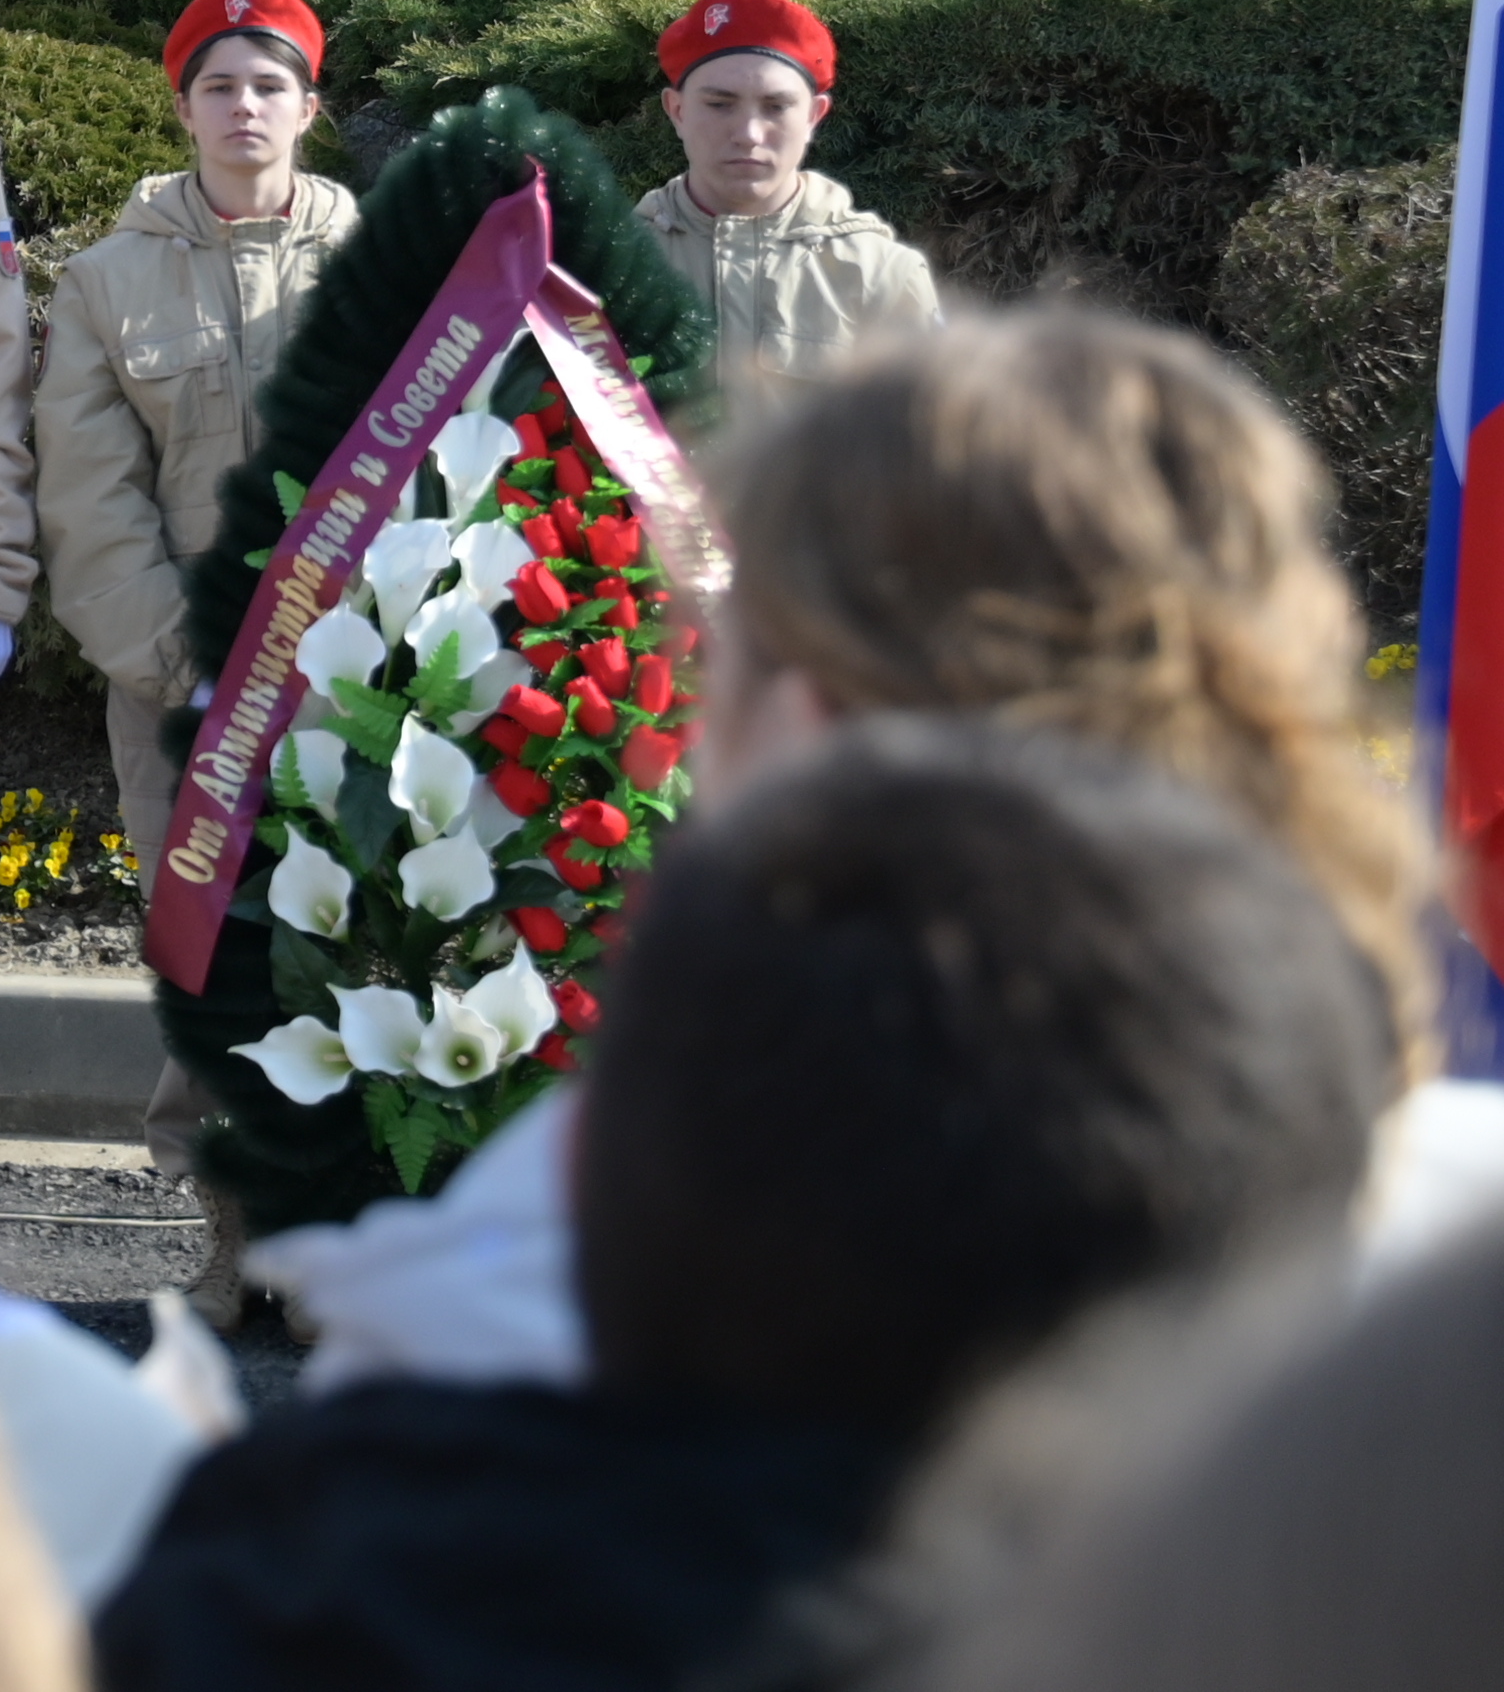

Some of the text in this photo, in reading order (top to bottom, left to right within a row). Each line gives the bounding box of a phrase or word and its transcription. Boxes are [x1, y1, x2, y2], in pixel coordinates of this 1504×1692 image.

[168, 313, 484, 885] От Администрации и Совета
